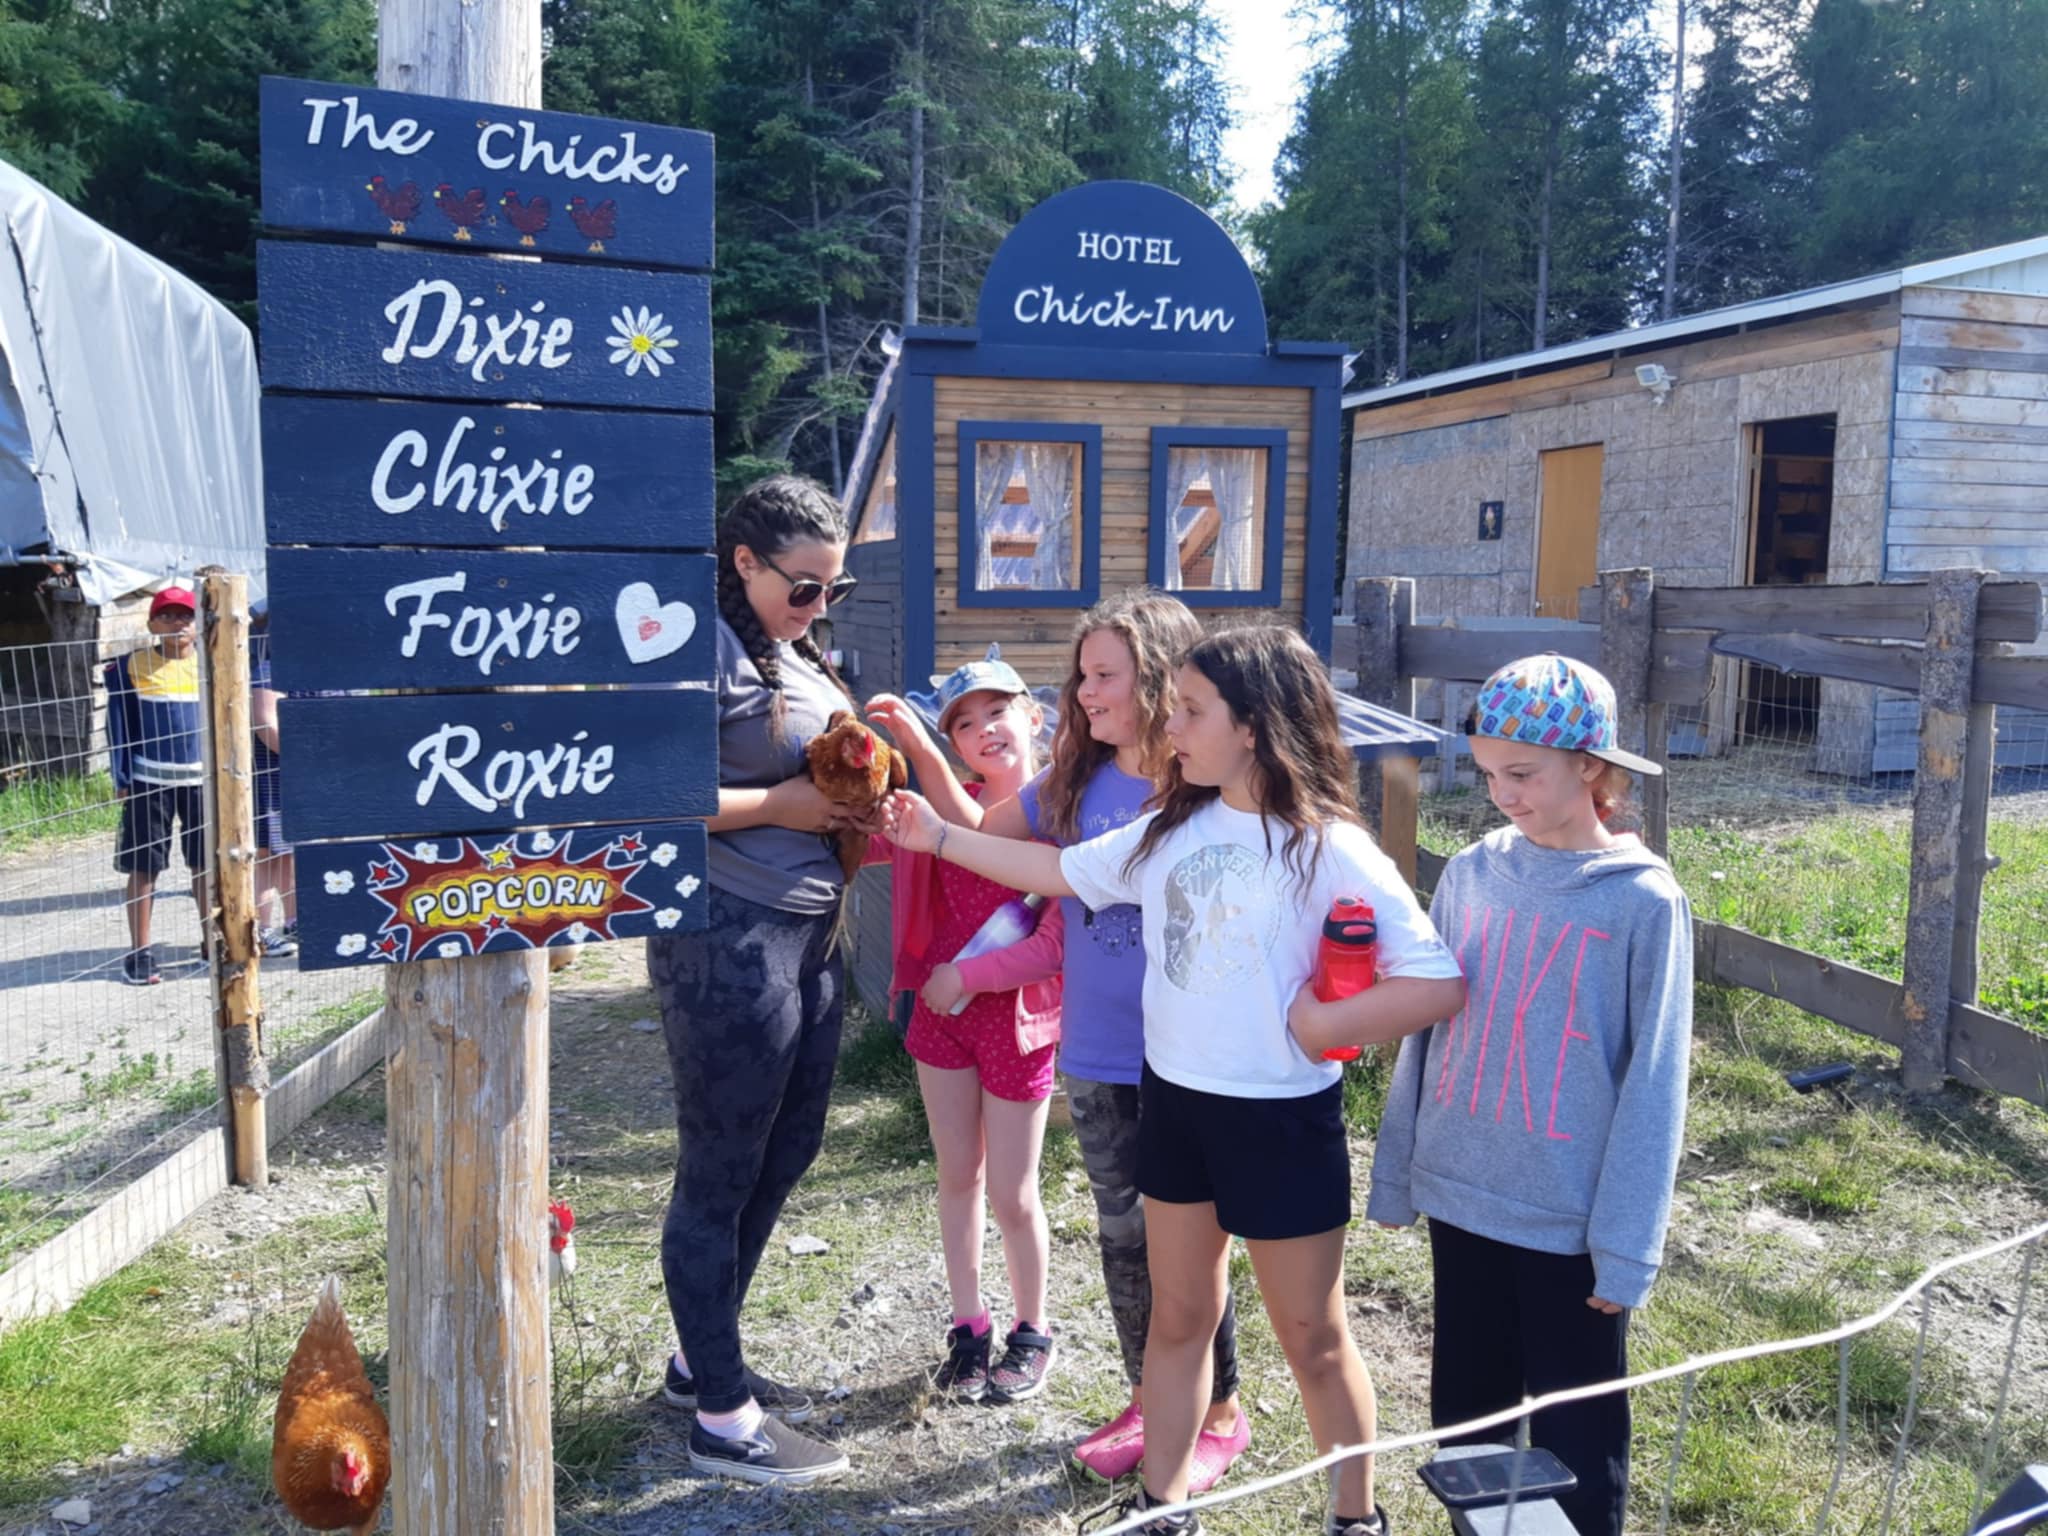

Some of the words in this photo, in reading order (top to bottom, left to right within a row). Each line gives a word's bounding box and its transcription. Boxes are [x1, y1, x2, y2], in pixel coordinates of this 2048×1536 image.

[303, 96, 434, 155] The
[478, 120, 689, 195] Chicks
[1077, 232, 1181, 266] HOTEL
[381, 279, 573, 383] Dixie
[1014, 284, 1234, 333] Chick-Inn
[371, 416, 595, 532] Chixie
[385, 571, 580, 675] Foxie
[408, 723, 614, 819] Roxie
[412, 875, 607, 924] POPCORN
